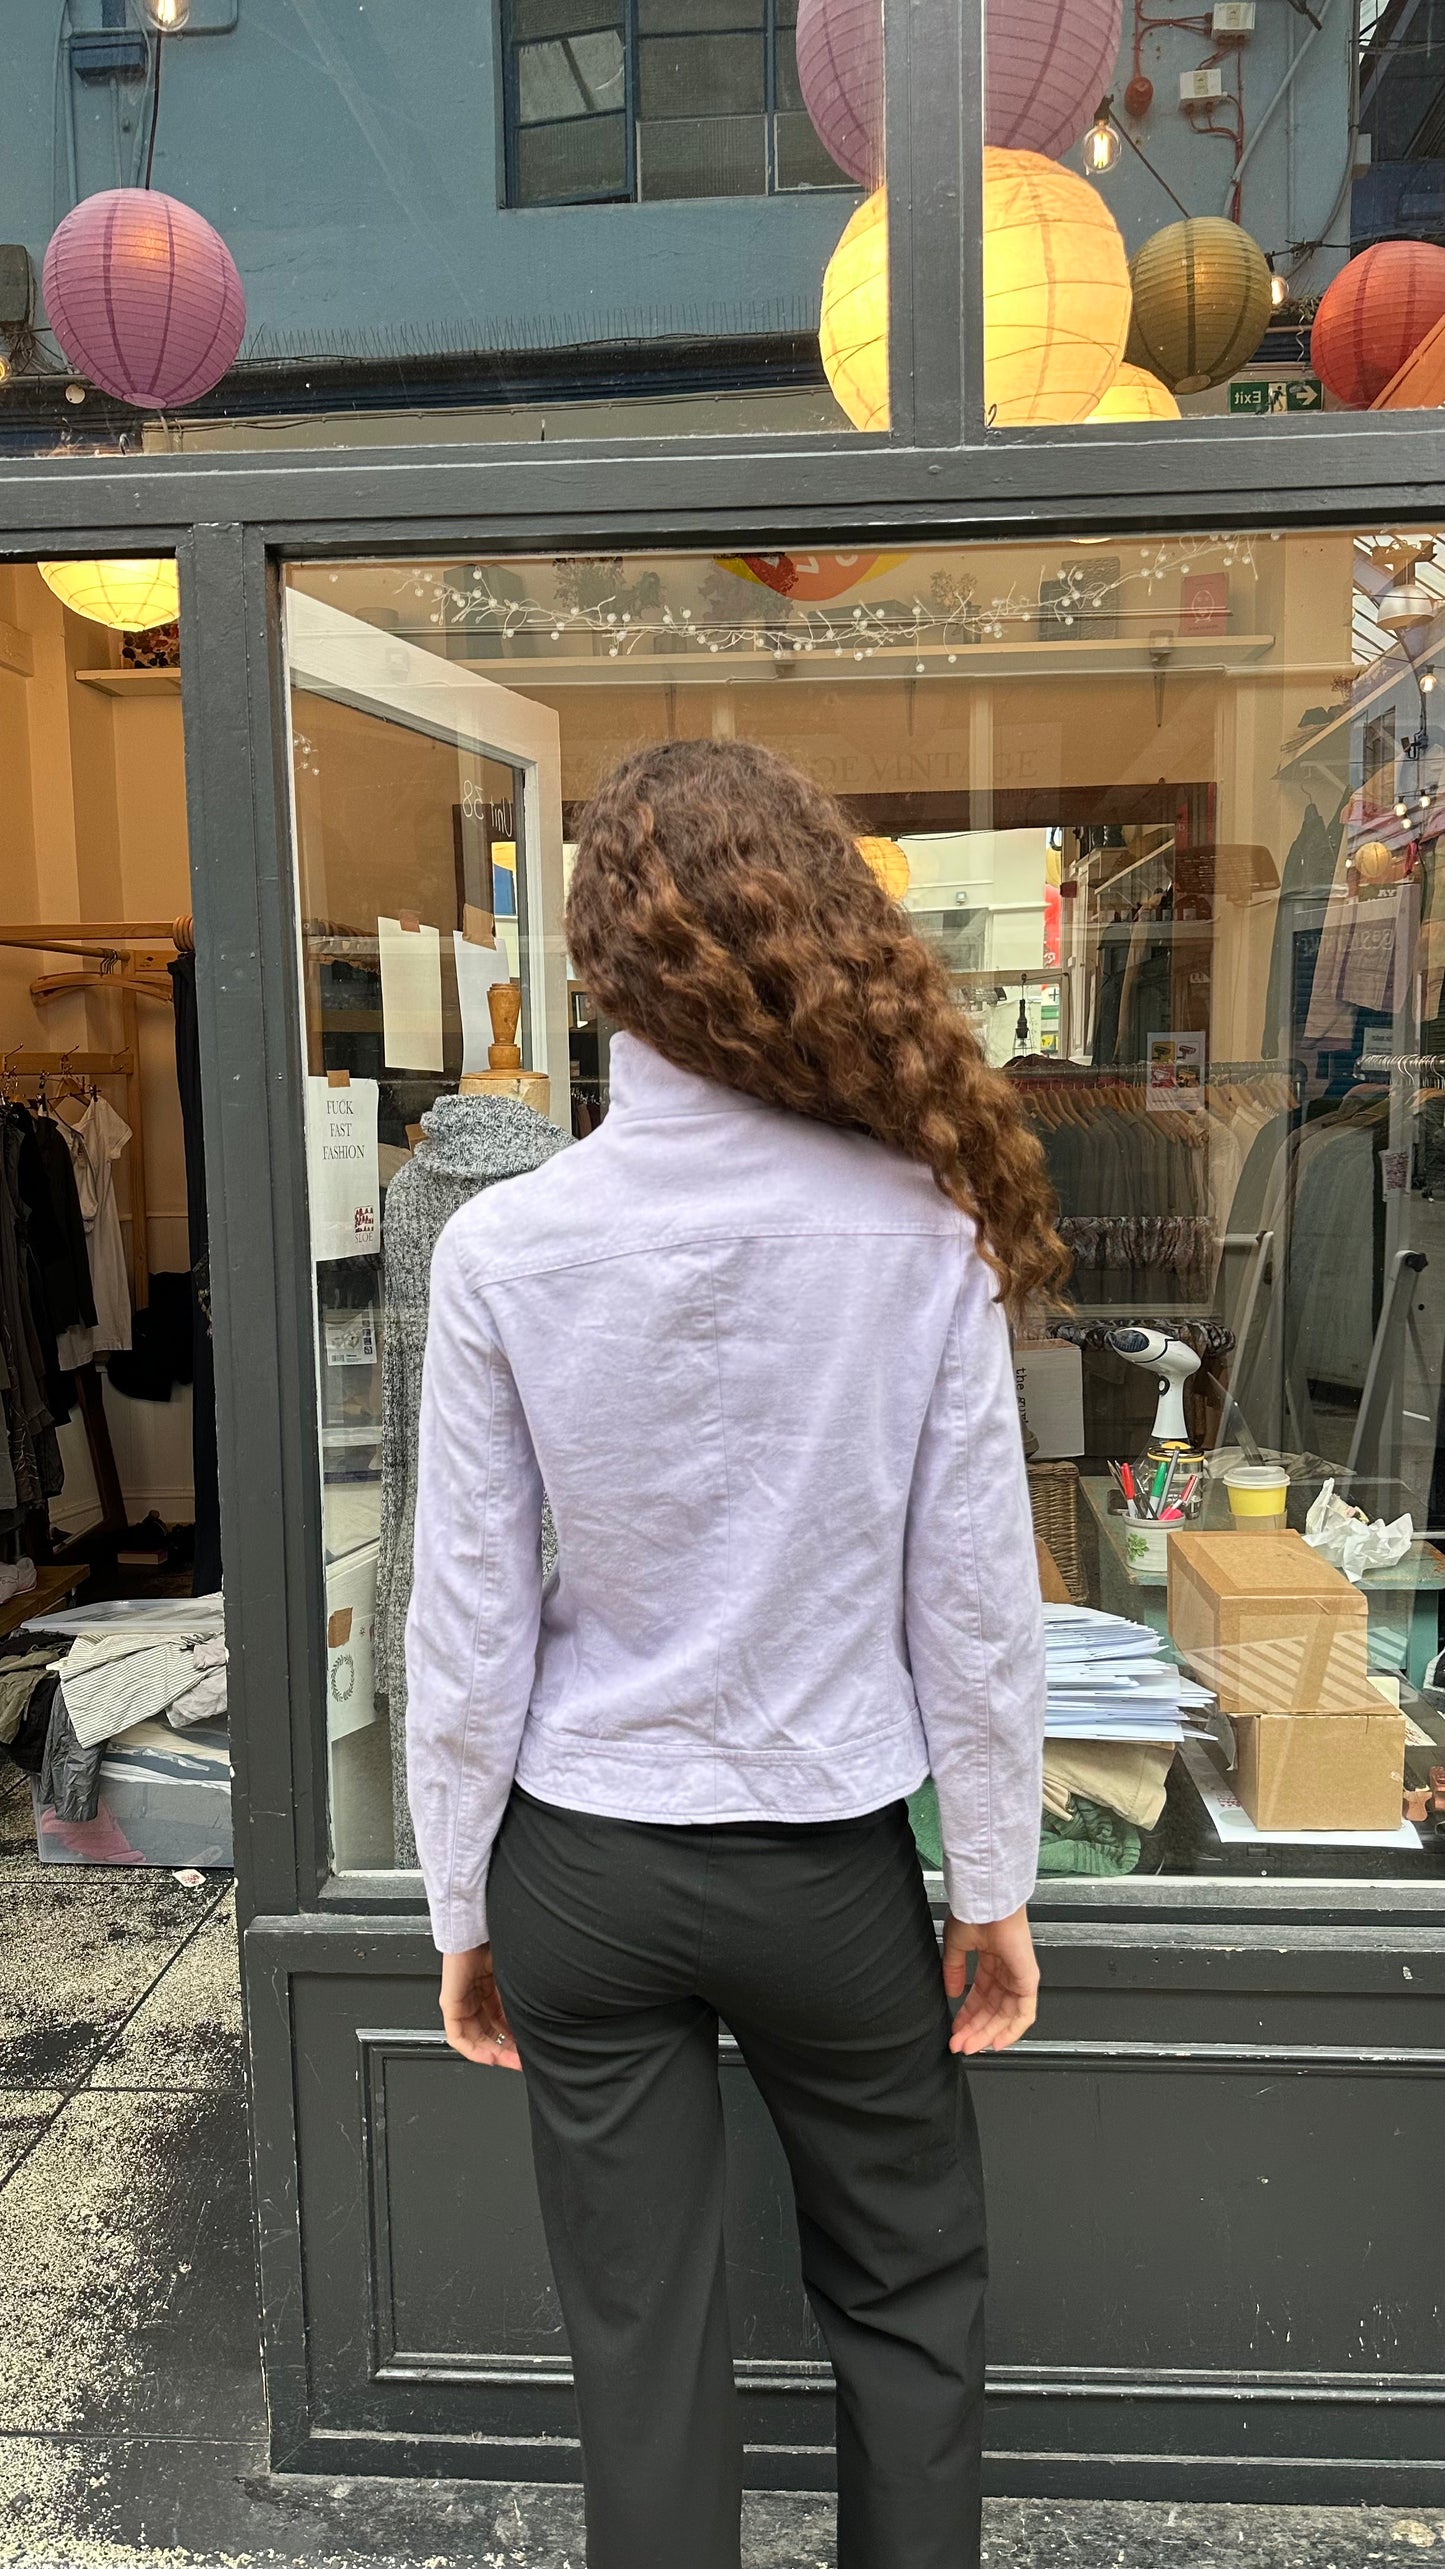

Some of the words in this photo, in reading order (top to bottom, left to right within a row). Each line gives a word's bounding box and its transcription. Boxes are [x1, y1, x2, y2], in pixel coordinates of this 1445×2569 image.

[326, 1100, 354, 1115] FUCK
[330, 1122, 353, 1137] FAST
[322, 1144, 365, 1160] FASHION
[354, 1232, 374, 1244] SLOE
[1015, 1367, 1028, 1390] the
